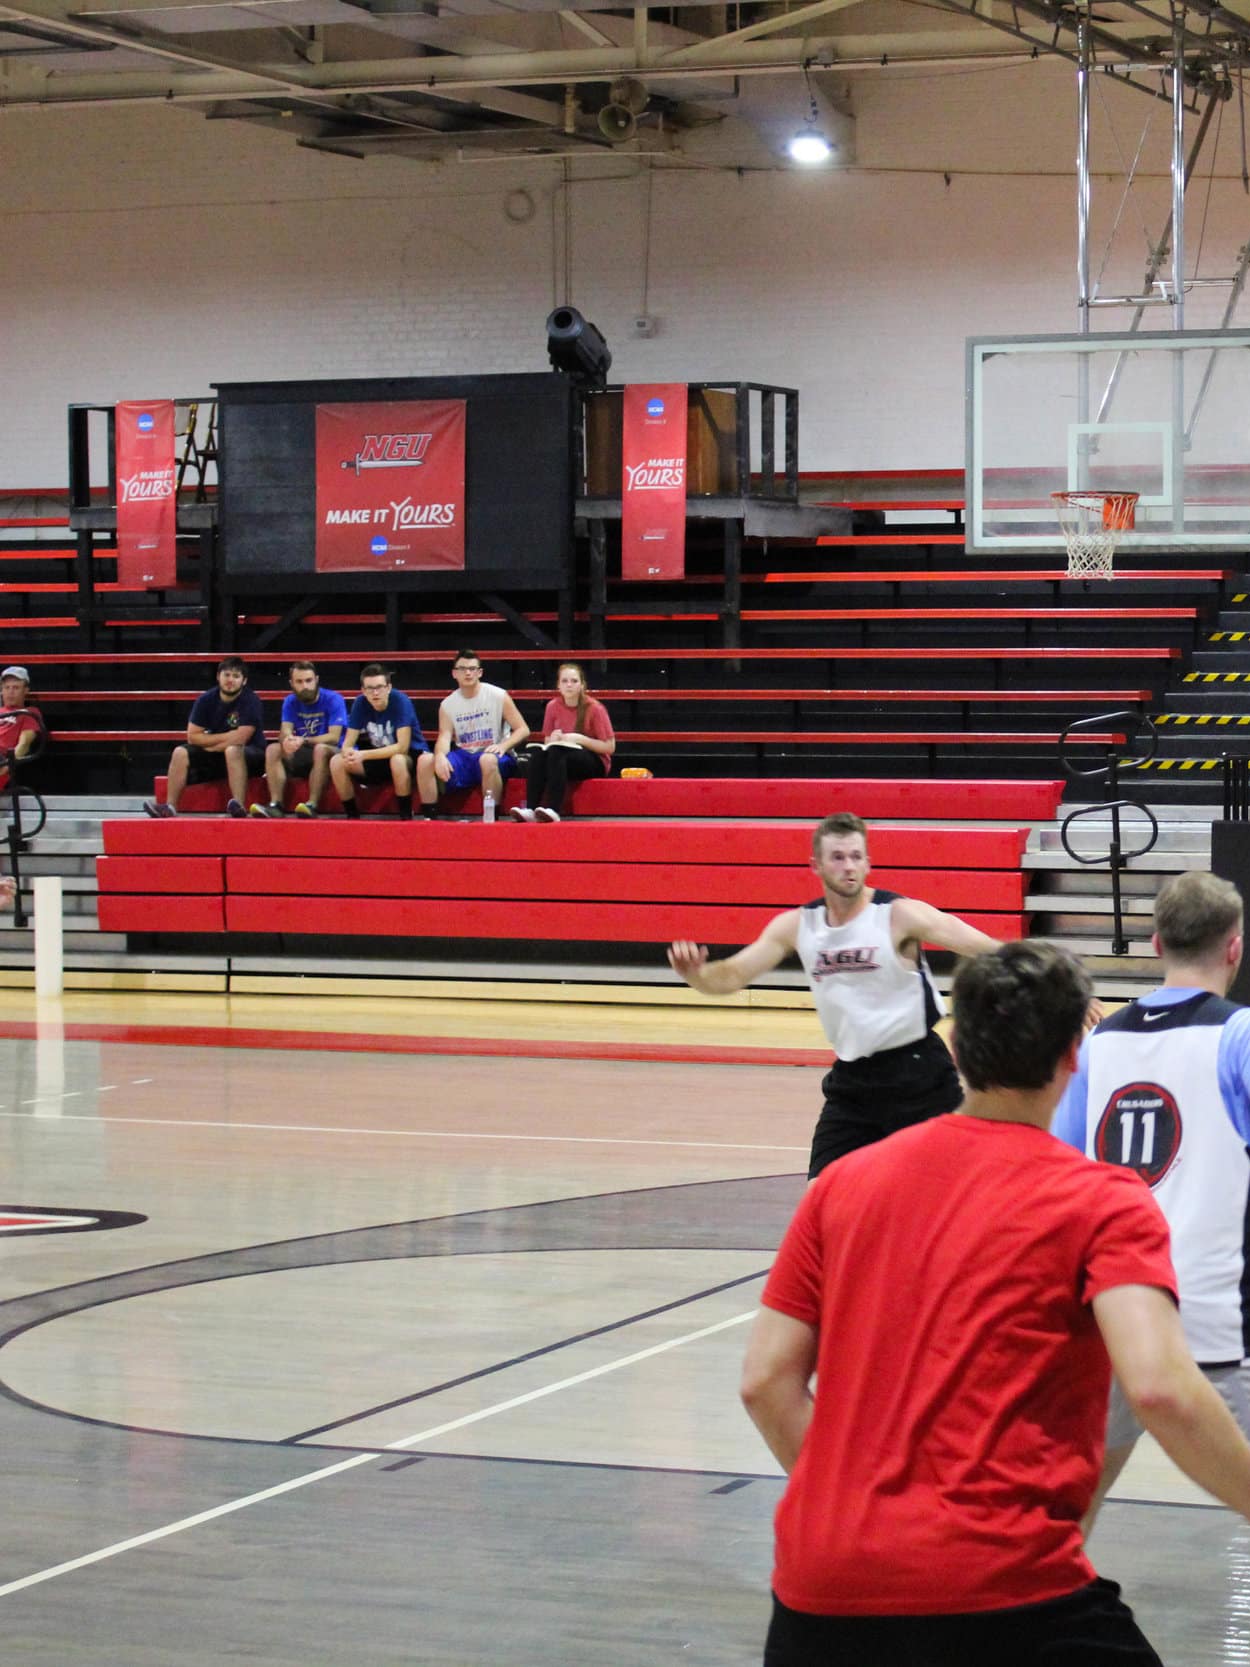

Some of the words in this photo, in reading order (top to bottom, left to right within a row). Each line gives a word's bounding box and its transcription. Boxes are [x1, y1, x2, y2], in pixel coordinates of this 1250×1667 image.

[361, 433, 432, 461] NGU
[140, 471, 165, 480] MAKE
[164, 470, 173, 479] IT
[625, 462, 683, 491] YOURS
[647, 458, 675, 467] MAKE
[675, 458, 684, 467] IT
[120, 474, 173, 503] YOURS
[325, 510, 371, 524] MAKE
[373, 509, 390, 523] IT
[389, 496, 456, 531] YOURS
[1120, 1112, 1155, 1164] 11
